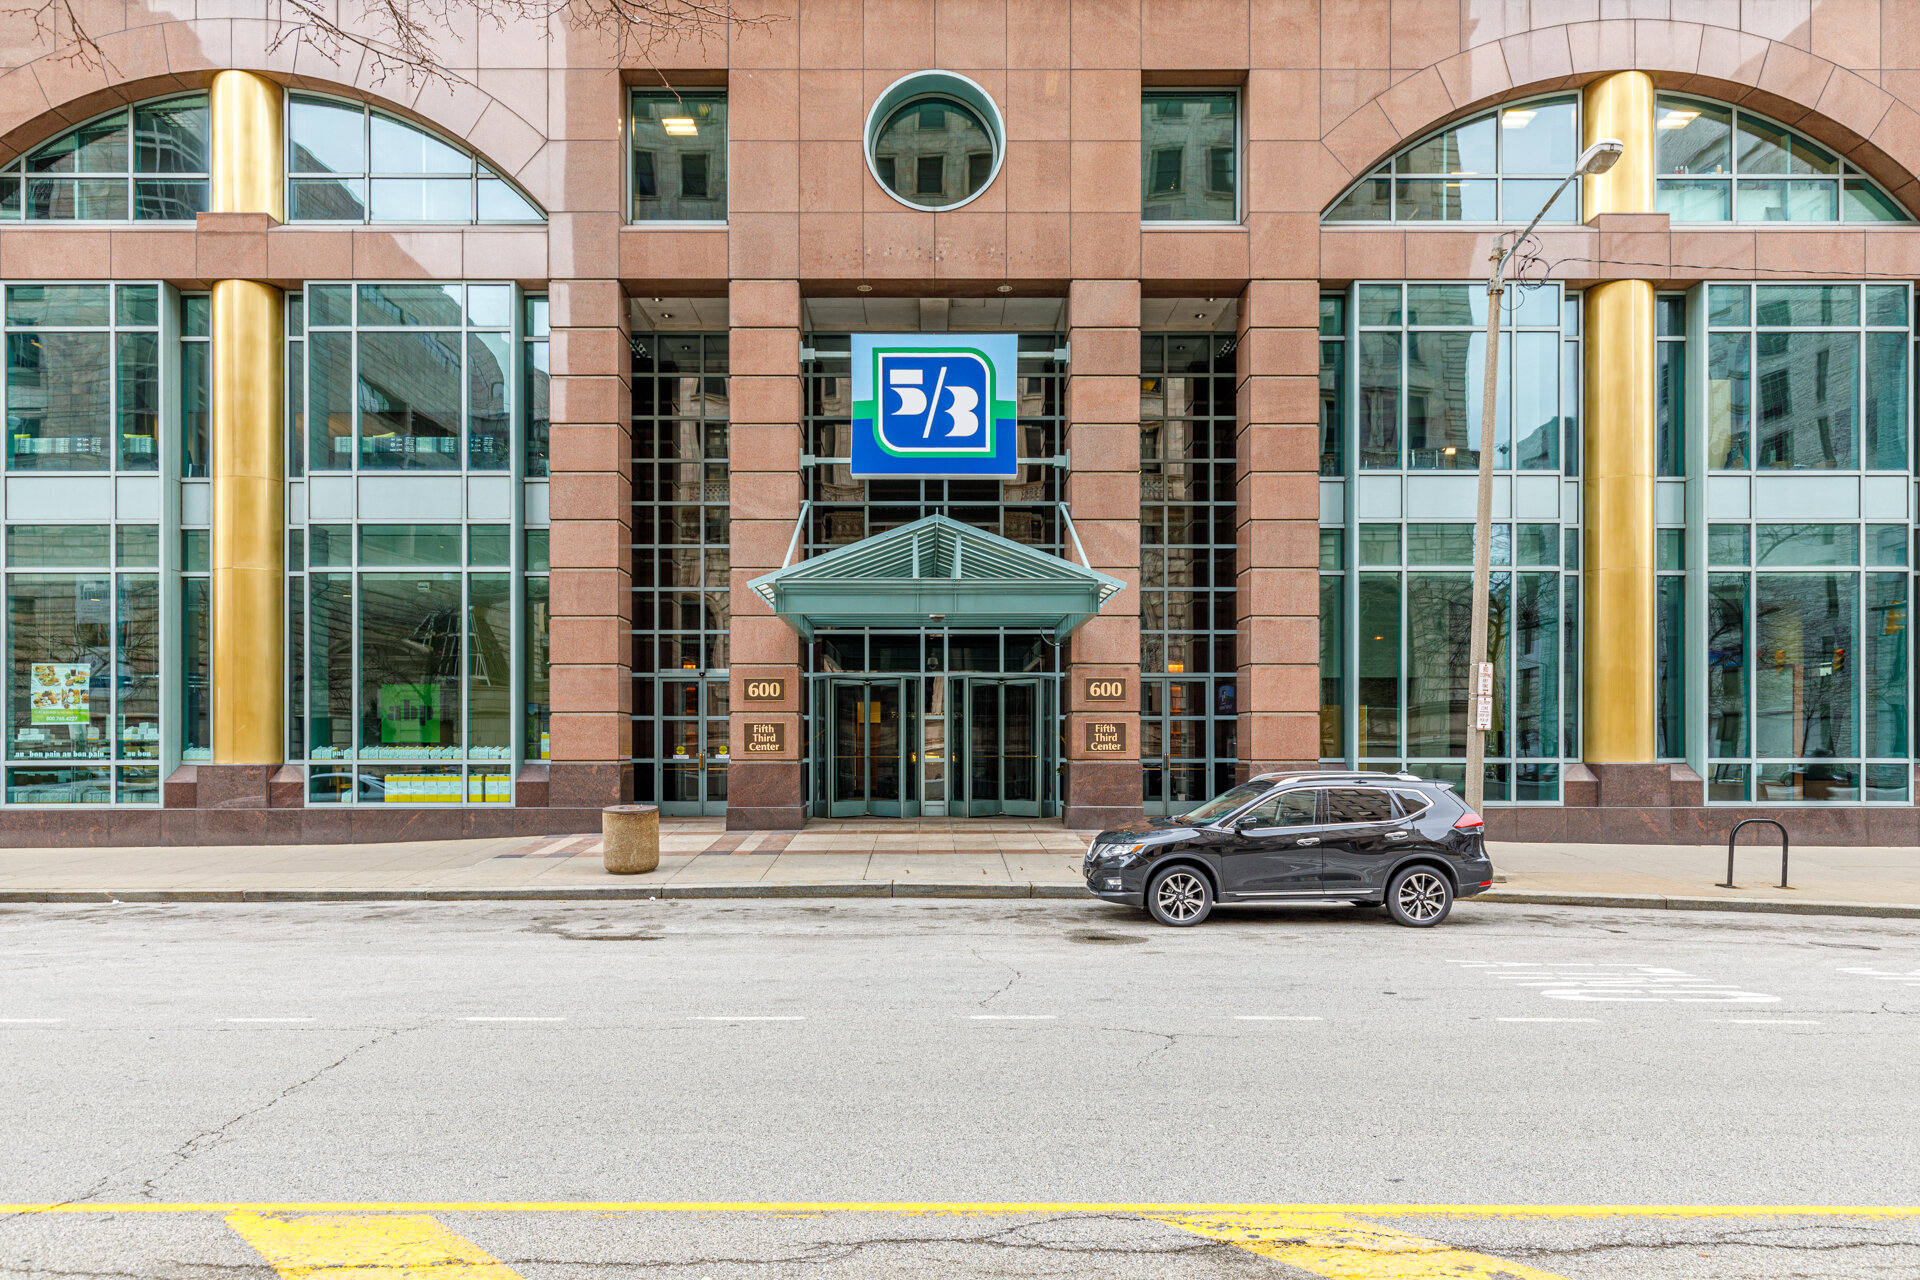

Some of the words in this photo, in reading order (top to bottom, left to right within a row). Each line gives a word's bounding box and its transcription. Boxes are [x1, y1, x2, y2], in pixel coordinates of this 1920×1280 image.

[748, 682, 780, 697] 600
[1089, 681, 1122, 697] 600
[388, 699, 434, 726] abp
[753, 724, 775, 733] Fifth
[1095, 724, 1116, 733] Fifth
[752, 733, 776, 742] Third
[1093, 733, 1118, 742] Third
[748, 742, 780, 751] Center
[1090, 742, 1122, 751] Center
[44, 751, 61, 759] pain
[88, 751, 104, 759] pain
